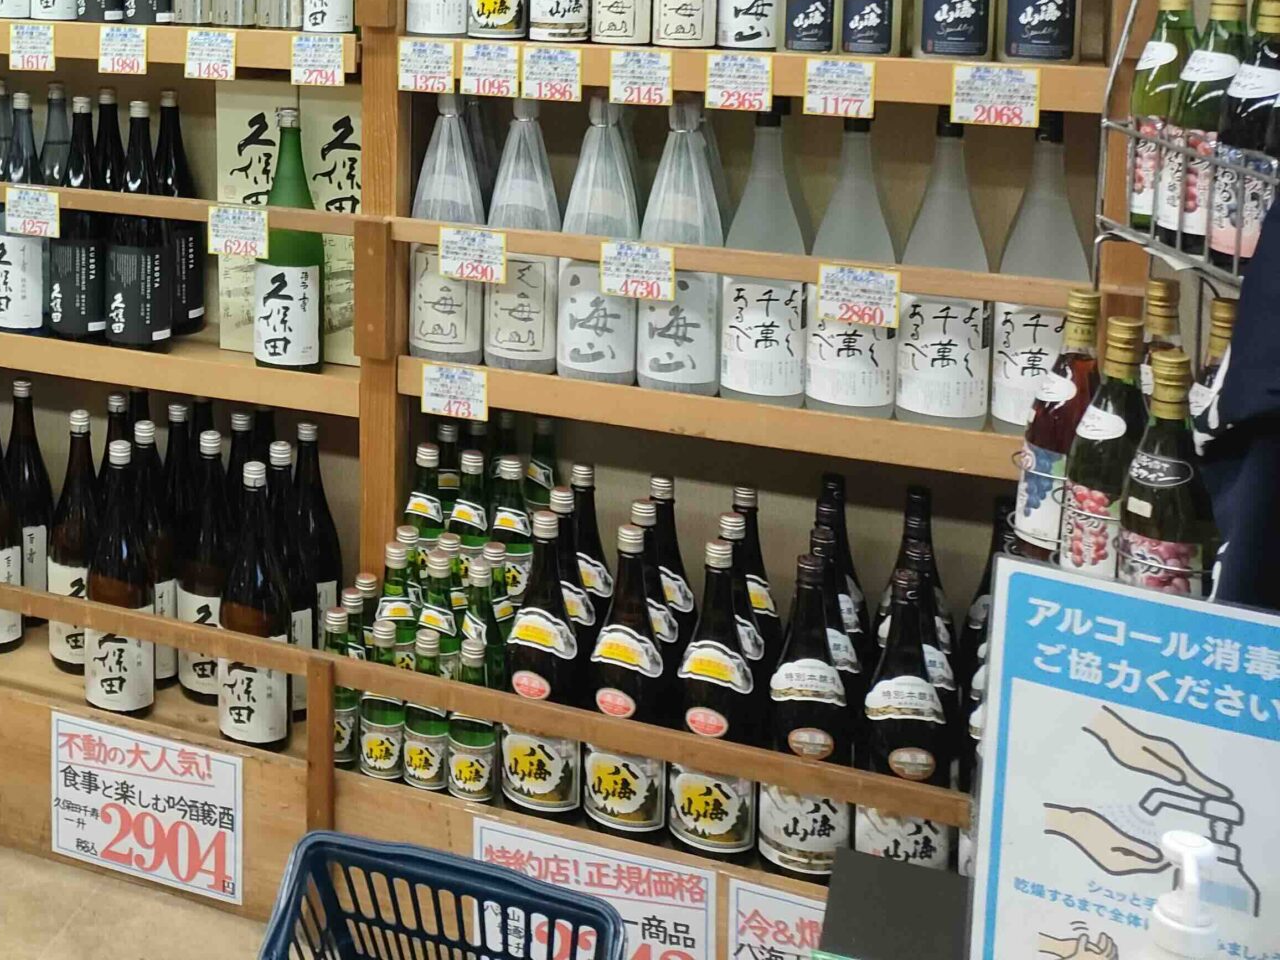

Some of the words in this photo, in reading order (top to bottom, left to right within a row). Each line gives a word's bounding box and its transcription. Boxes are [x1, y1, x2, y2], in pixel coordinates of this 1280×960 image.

[793, 1, 826, 29] 八海山
[848, 2, 882, 30] 八海山
[20, 55, 48, 70] 1617
[111, 58, 140, 73] 1980
[197, 62, 228, 79] 1485
[304, 69, 336, 85] 2794
[412, 74, 447, 92] 1375
[475, 78, 510, 96] 1095
[536, 81, 573, 100] 1386
[624, 86, 663, 104] 2145
[720, 91, 763, 110] 2365
[821, 97, 864, 116] 1177
[974, 105, 1023, 126] 2068
[20, 219, 48, 236] 4257
[224, 239, 257, 257] 6248
[456, 261, 494, 282] 4290
[620, 279, 661, 299] 4730
[51, 282, 63, 323] 久保田
[109, 292, 126, 334] 久保田
[838, 302, 884, 325] 2860
[257, 272, 293, 358] 久保田
[754, 290, 780, 350] 千萬
[930, 306, 959, 369] 千萬
[443, 400, 471, 419] 473
[1026, 597, 1280, 681] アルコール消毒
[1031, 642, 1280, 723] ご協力ください
[58, 730, 214, 781] 不動の大人気!
[507, 744, 552, 782] 八海山
[592, 762, 637, 801] 八海山
[680, 781, 730, 823] 八海山
[782, 796, 839, 843] 八海山
[75, 838, 98, 857] 税込
[100, 802, 233, 894] 2904
[882, 820, 942, 862] 八海山
[484, 844, 706, 904] 特約店!正規価格
